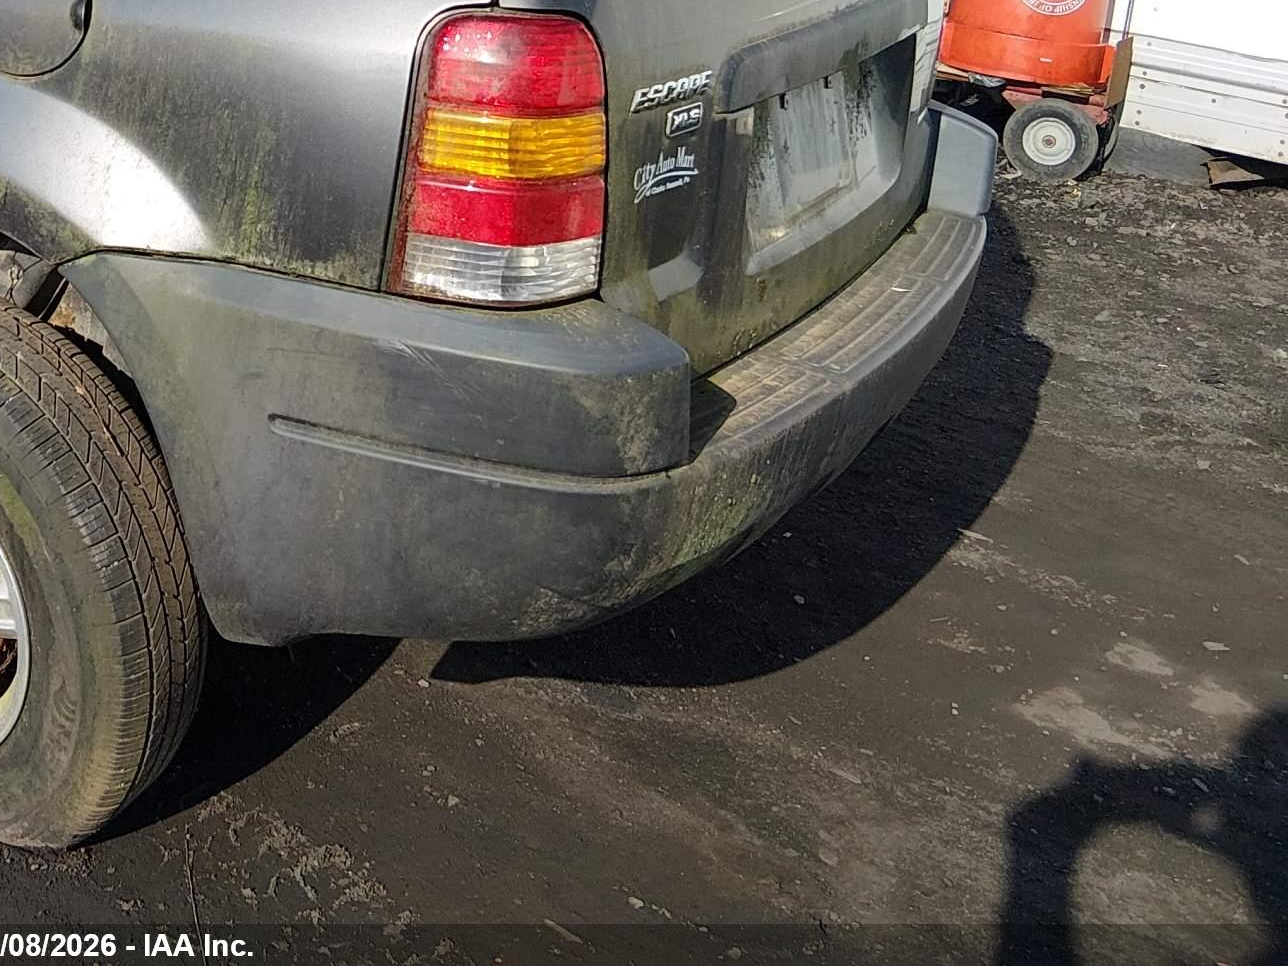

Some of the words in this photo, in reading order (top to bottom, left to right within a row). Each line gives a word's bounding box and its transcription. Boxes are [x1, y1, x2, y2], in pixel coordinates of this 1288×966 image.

[630, 70, 713, 114] ESCAPE
[672, 108, 700, 130] XLS
[634, 162, 657, 202] City
[656, 151, 675, 175] Auto
[675, 146, 695, 168] Mart
